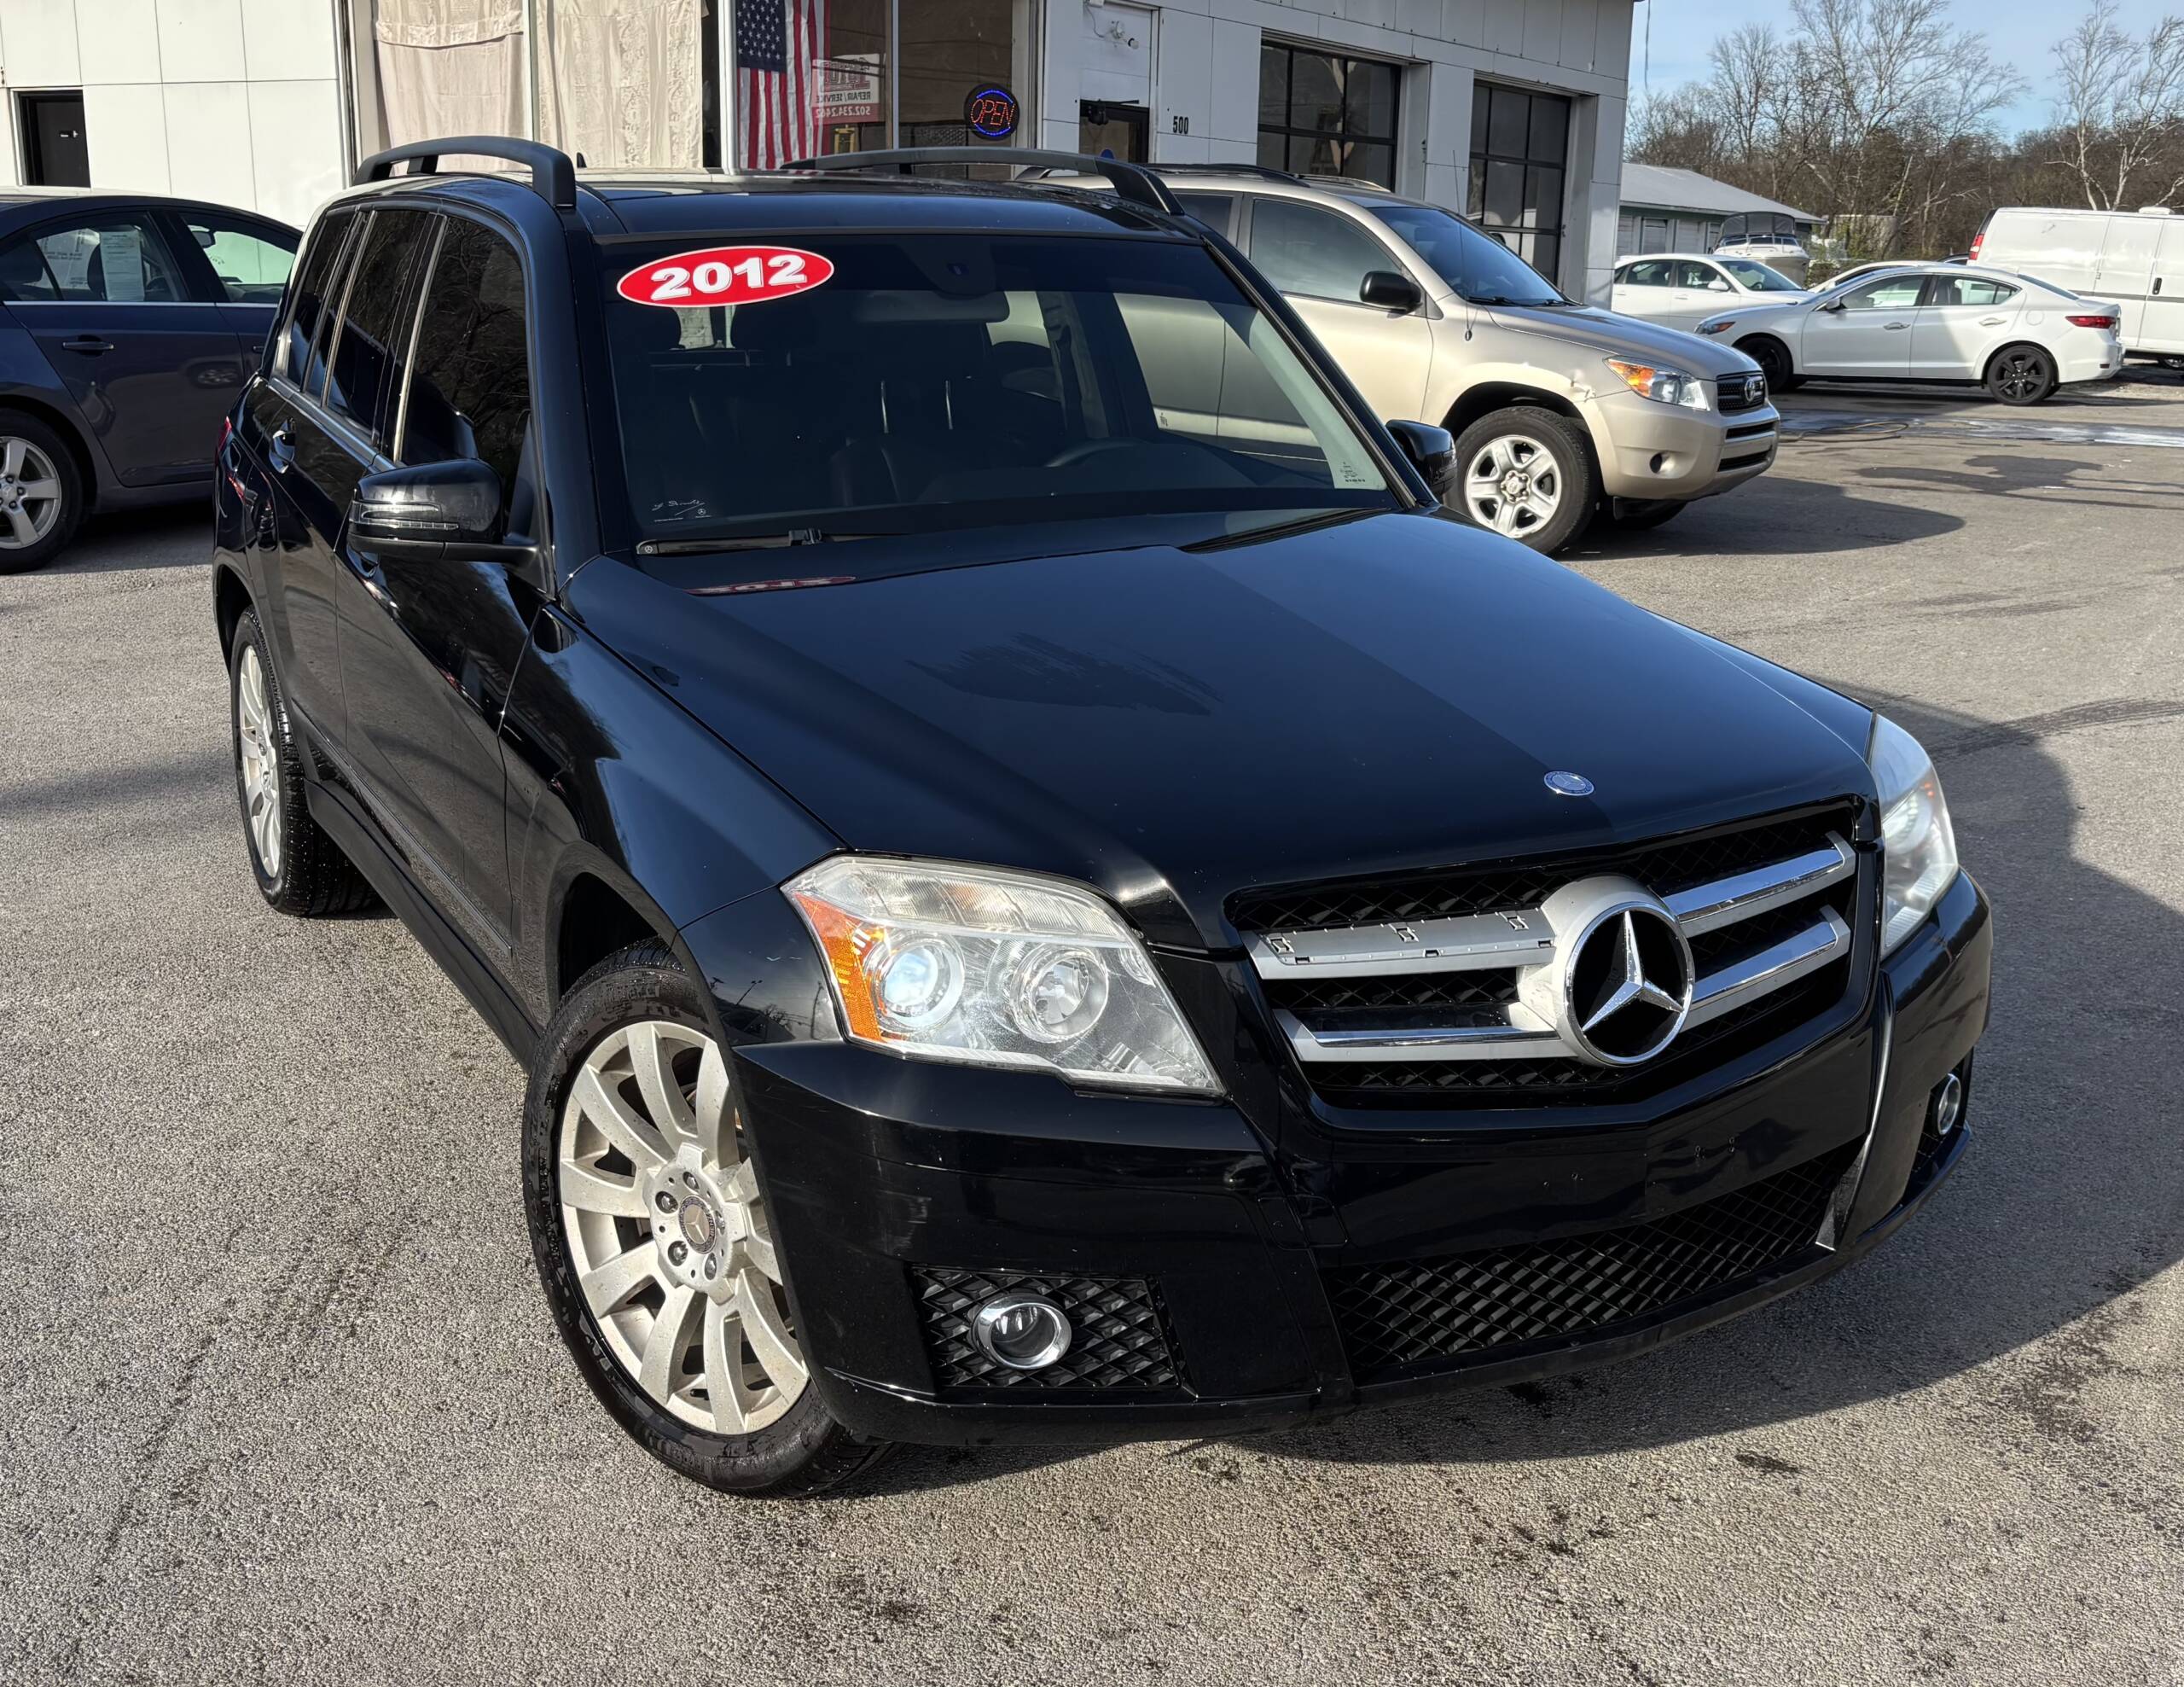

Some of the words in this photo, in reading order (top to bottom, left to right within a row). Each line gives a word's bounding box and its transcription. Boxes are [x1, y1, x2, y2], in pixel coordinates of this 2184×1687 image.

[970, 99, 1015, 129] OPEN
[1173, 115, 1189, 135] 500
[650, 254, 807, 301] 2012
